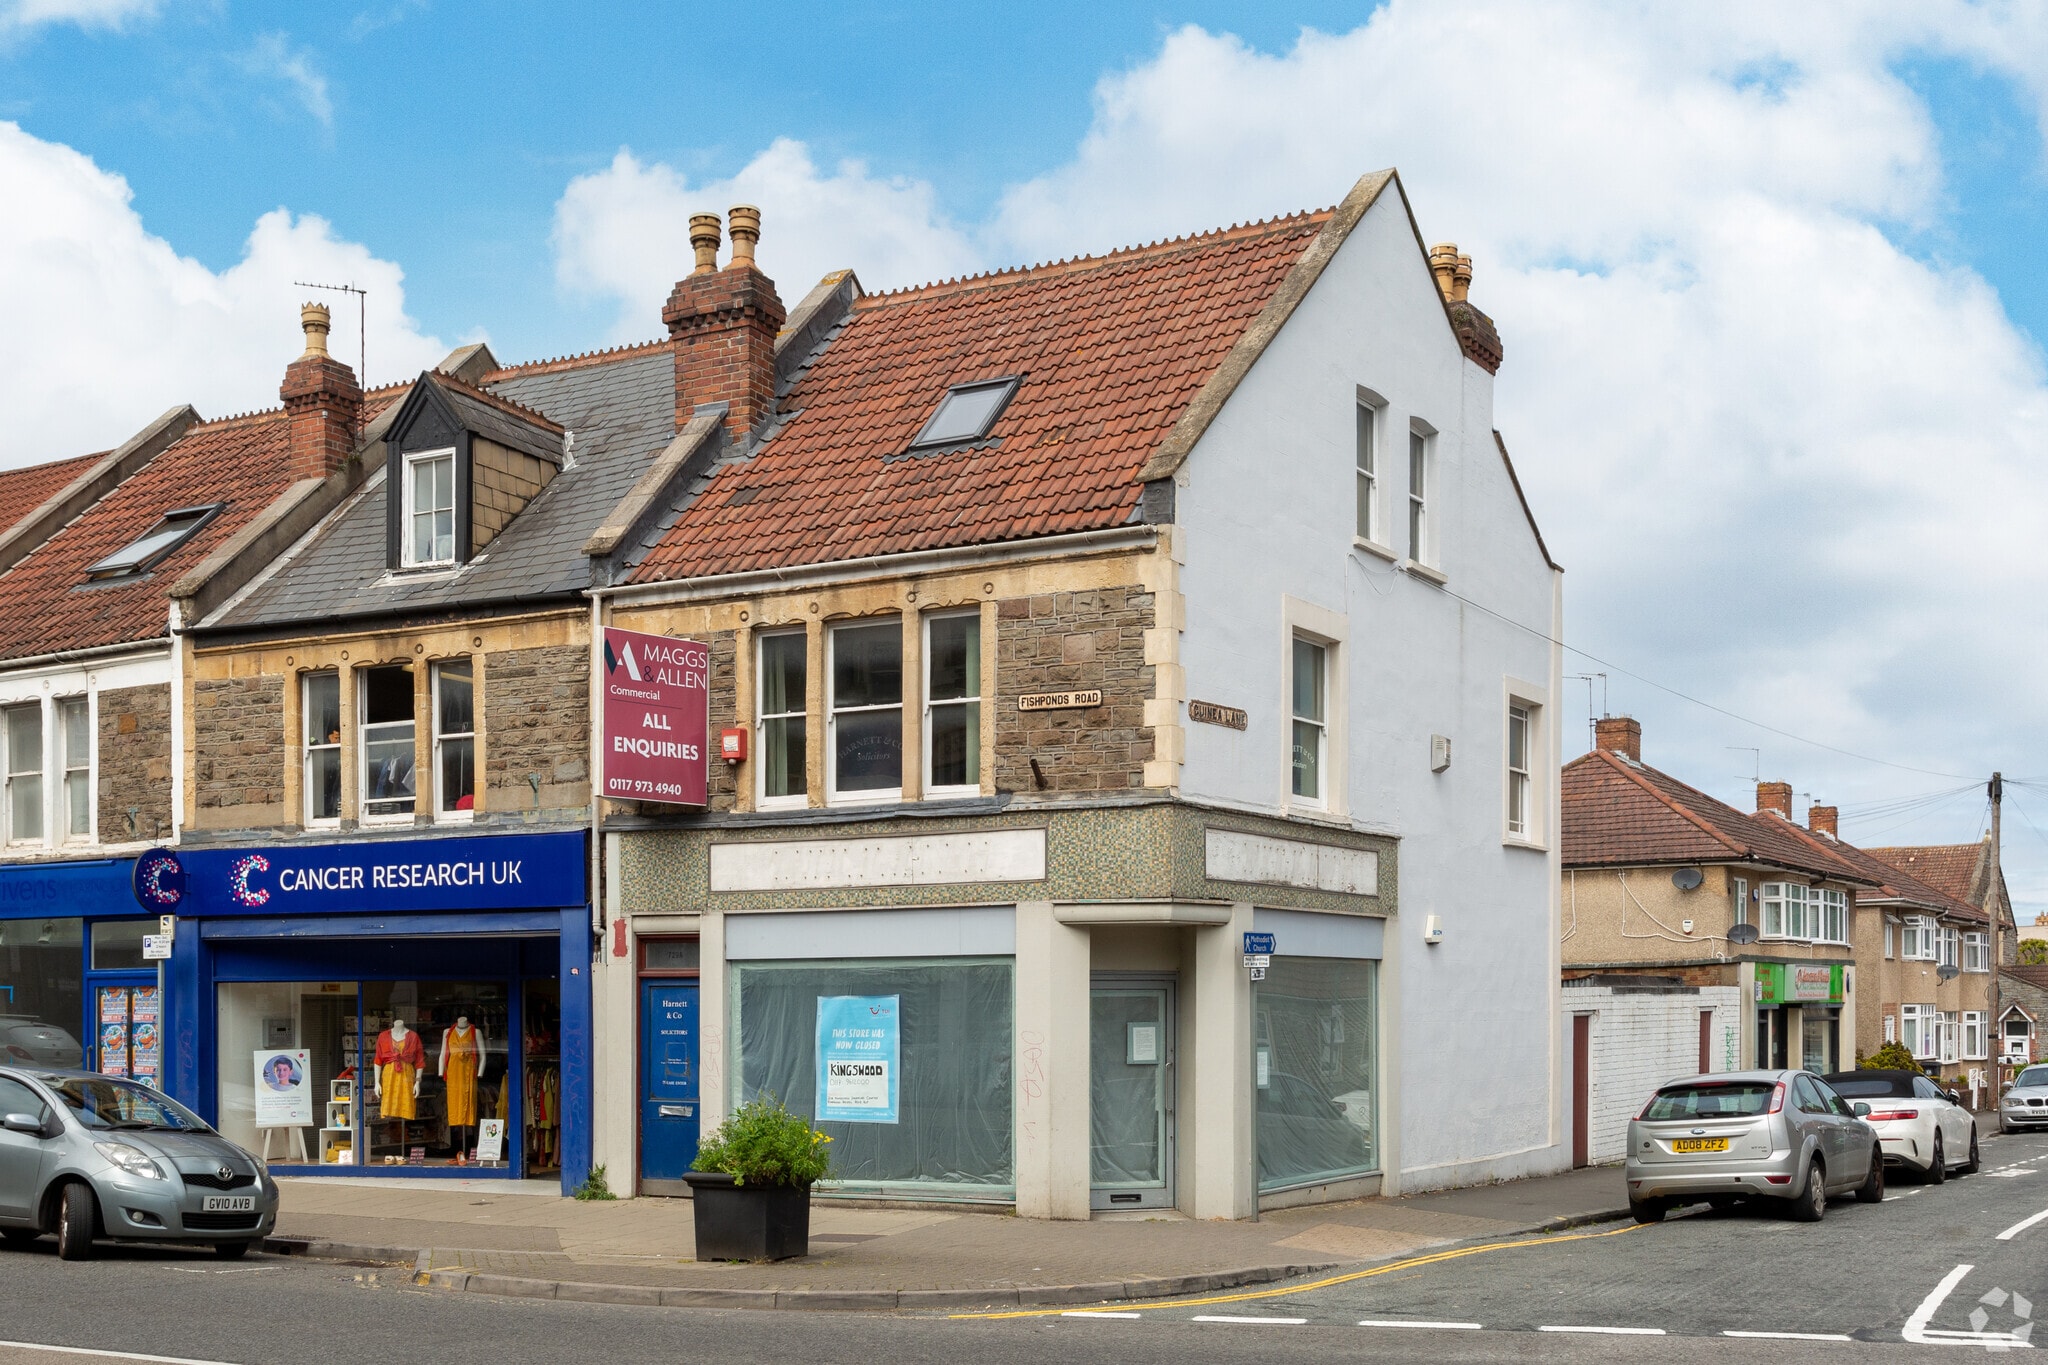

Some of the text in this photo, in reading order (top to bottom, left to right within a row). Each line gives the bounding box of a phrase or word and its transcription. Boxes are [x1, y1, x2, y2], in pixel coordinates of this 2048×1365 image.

[644, 643, 706, 668] MAGGS
[644, 666, 706, 690] & ALLEN
[610, 684, 660, 700] Commercial
[1020, 692, 1098, 708] FISHPONDS ROAD
[642, 712, 672, 730] ALL
[614, 736, 699, 760] ENQUIRIES
[610, 777, 682, 796] 0117 973 4940
[280, 866, 364, 891] CANCER
[372, 862, 484, 888] RESEARCH
[492, 860, 522, 884] UK
[832, 1028, 886, 1038] THIS STORE HAS
[836, 1041, 881, 1050] NOW CLOSED
[1676, 1139, 1724, 1150] AD08 ZFZ
[209, 1198, 250, 1210] GV10 AVB
